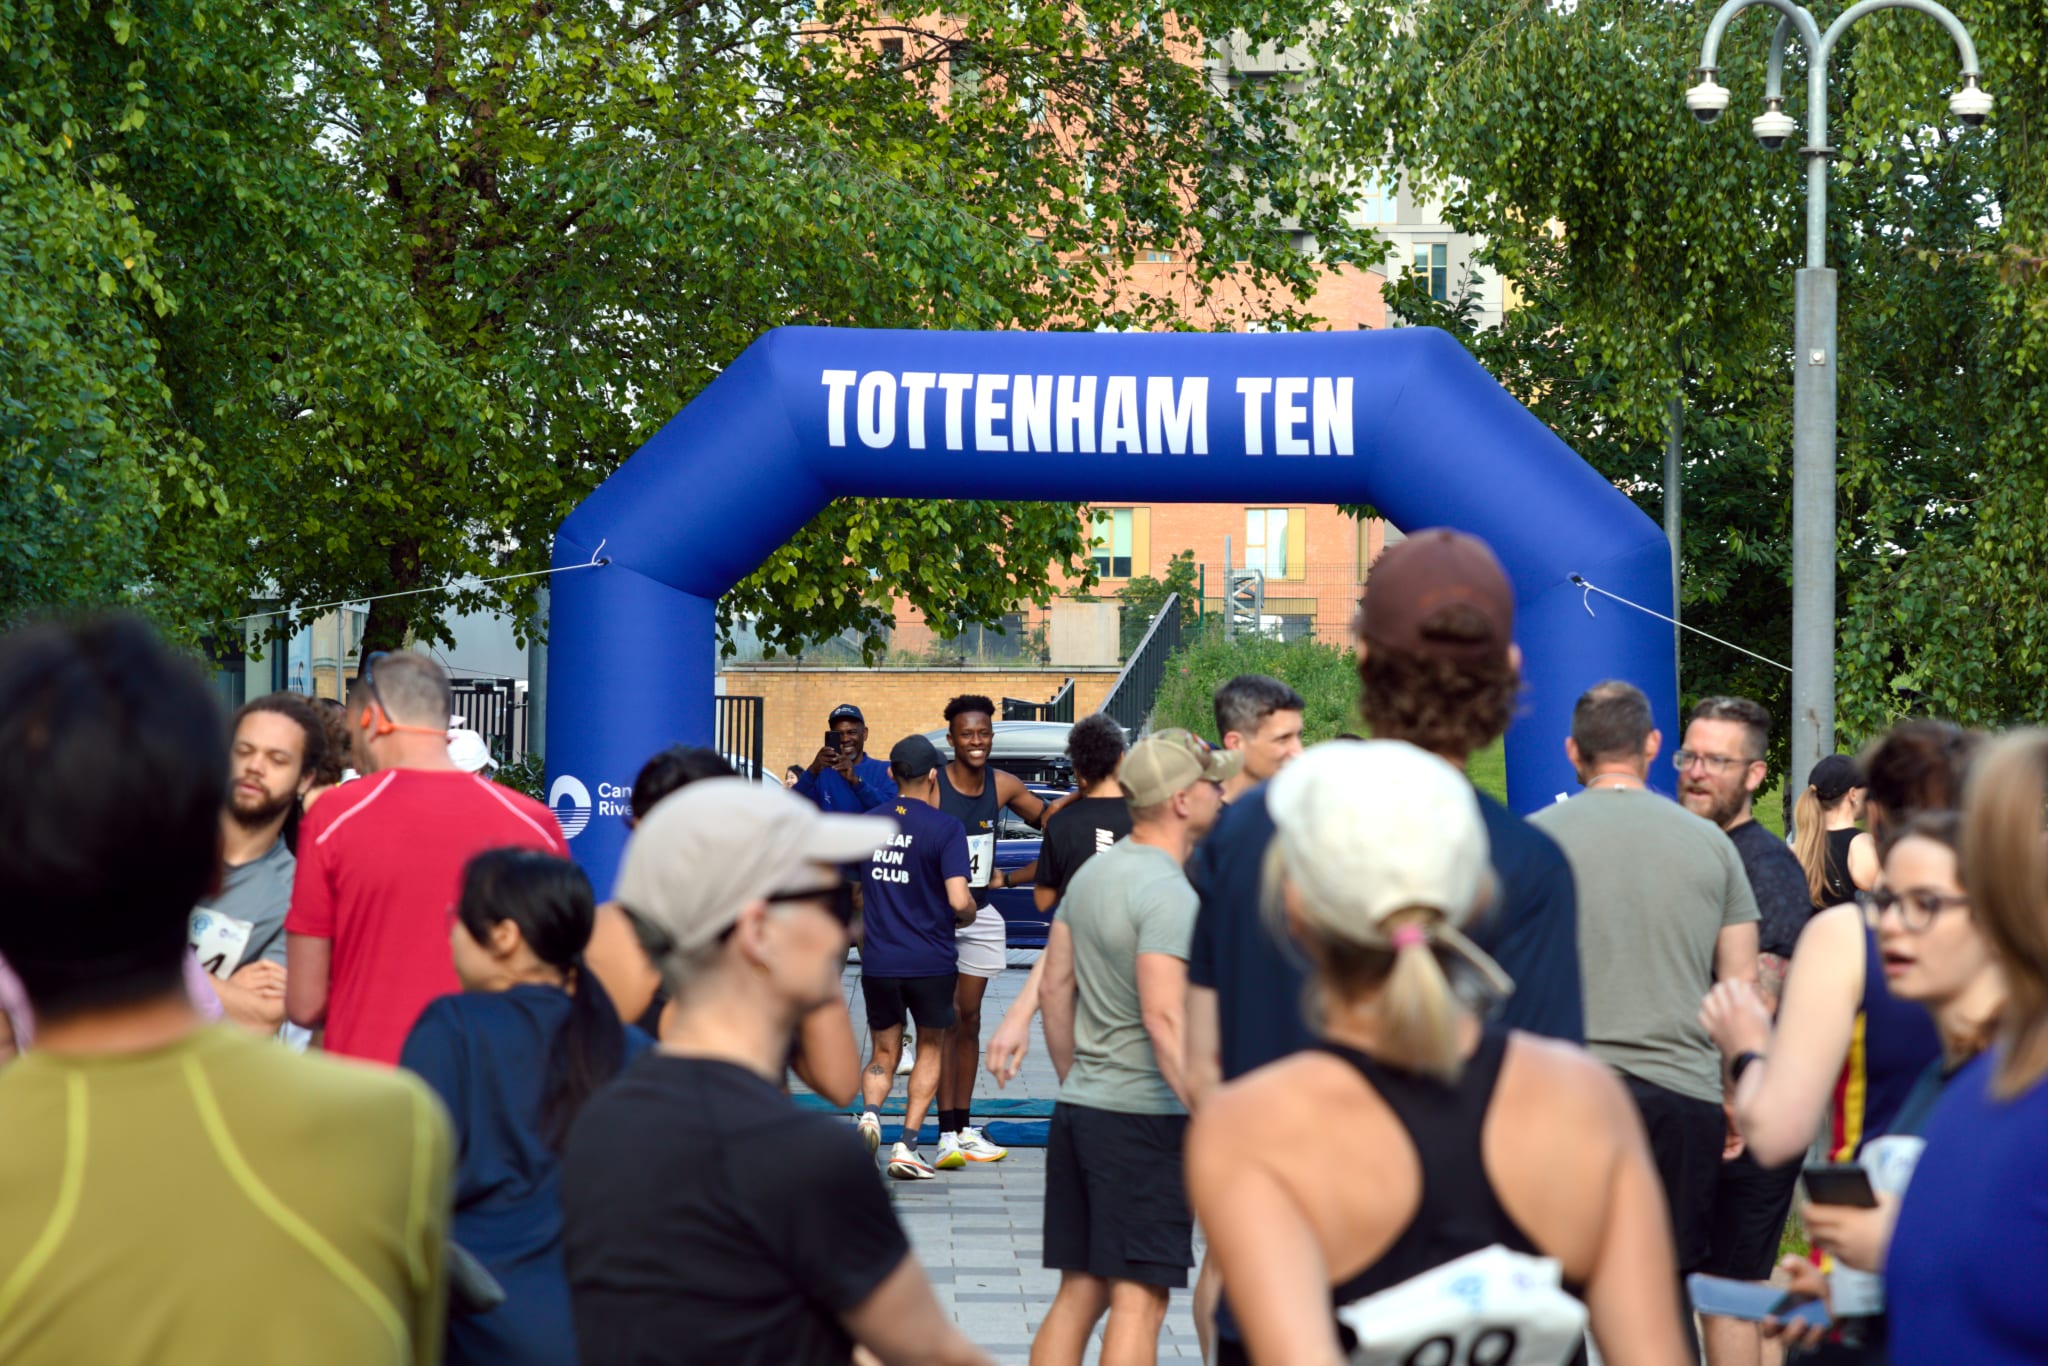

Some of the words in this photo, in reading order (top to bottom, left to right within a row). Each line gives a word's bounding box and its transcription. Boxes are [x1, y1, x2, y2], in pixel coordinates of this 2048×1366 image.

[821, 369, 1209, 455] TOTTENHAM
[1235, 376, 1354, 456] TEN
[597, 782, 632, 798] Can
[598, 800, 633, 816] Rive
[886, 833, 913, 848] EAF
[872, 848, 904, 865] RUN
[871, 867, 910, 884] CLUB
